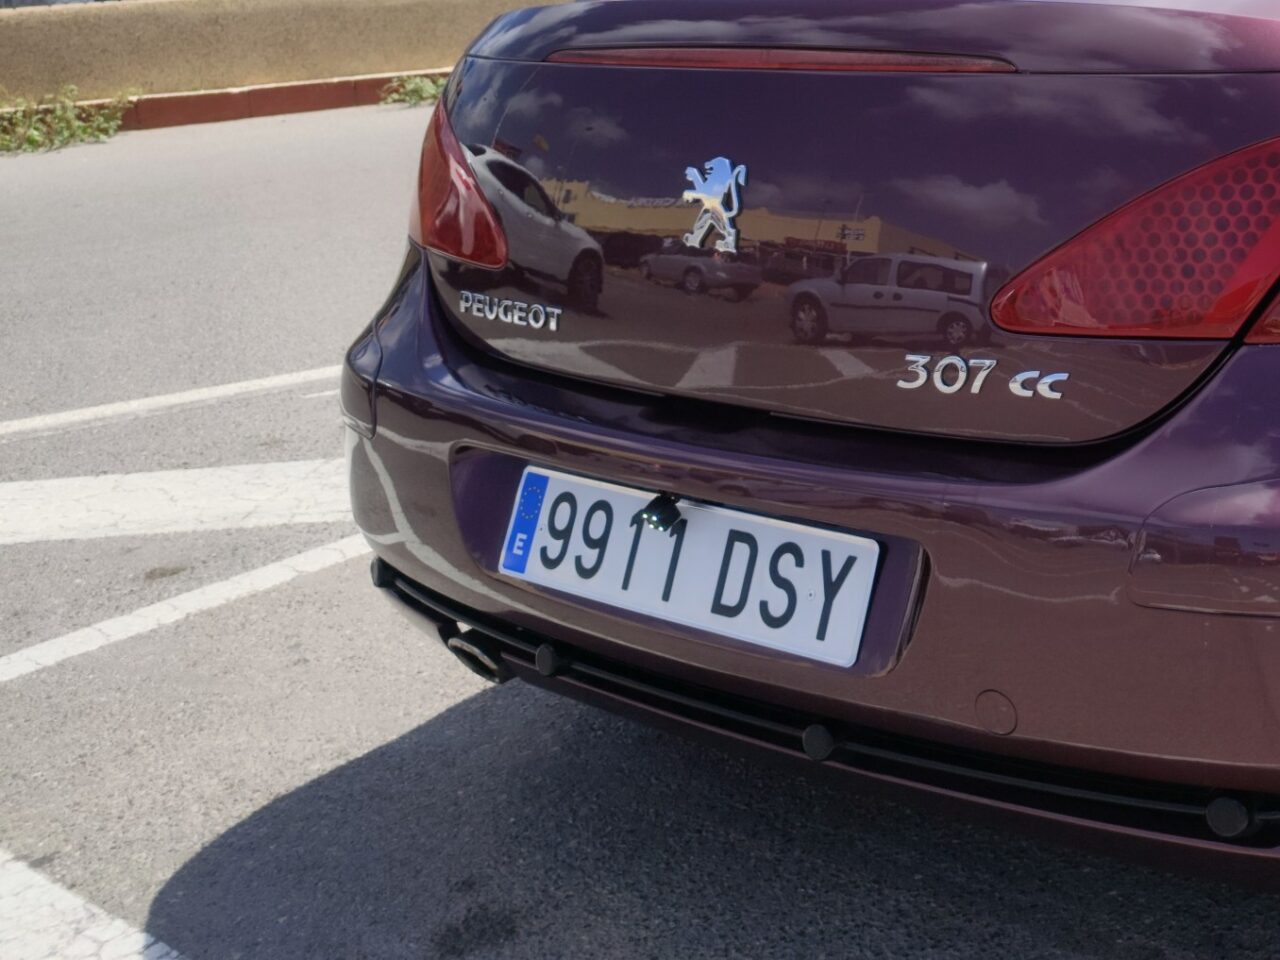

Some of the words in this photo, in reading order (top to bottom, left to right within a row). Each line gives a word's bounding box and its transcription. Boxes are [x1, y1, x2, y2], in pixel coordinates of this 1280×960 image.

[460, 290, 562, 331] PEUGEOT
[896, 354, 997, 394] 307
[511, 532, 528, 556] E
[539, 491, 688, 602] 9911
[710, 528, 858, 641] DSY
